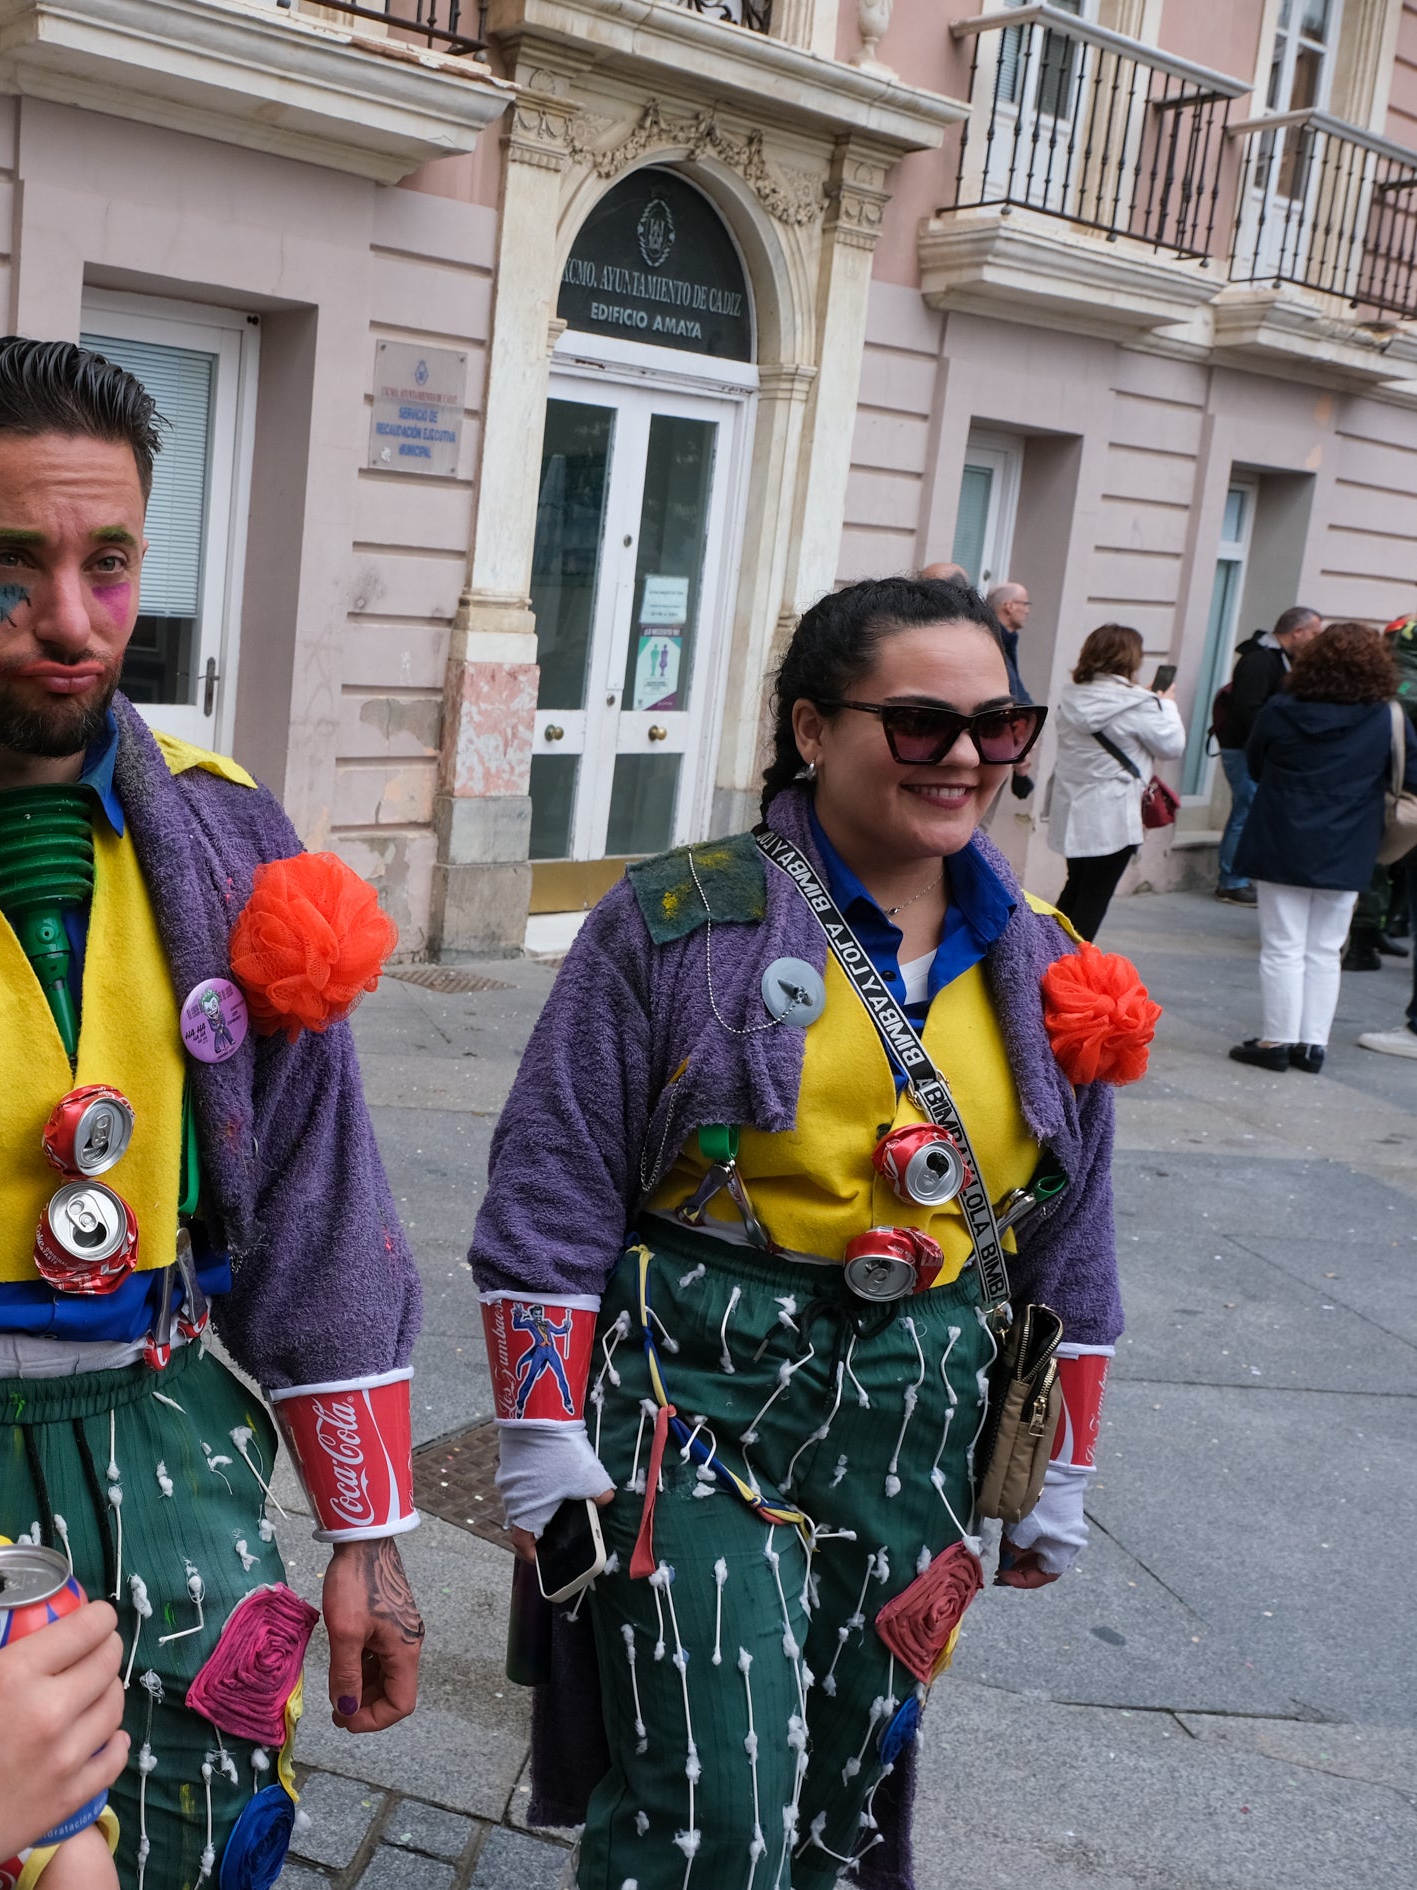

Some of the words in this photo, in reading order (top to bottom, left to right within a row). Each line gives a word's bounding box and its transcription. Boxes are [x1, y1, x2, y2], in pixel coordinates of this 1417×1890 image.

[561, 257, 597, 288] XCMO.
[599, 264, 691, 306] AYUNTAMIENTO
[692, 284, 707, 310] DE
[709, 287, 743, 317] CADIZ
[590, 302, 648, 329] EDIFICIO
[652, 315, 702, 340] AMAYA
[981, 1244, 1005, 1302] BIMB
[311, 1397, 374, 1526] Coca-Cola
